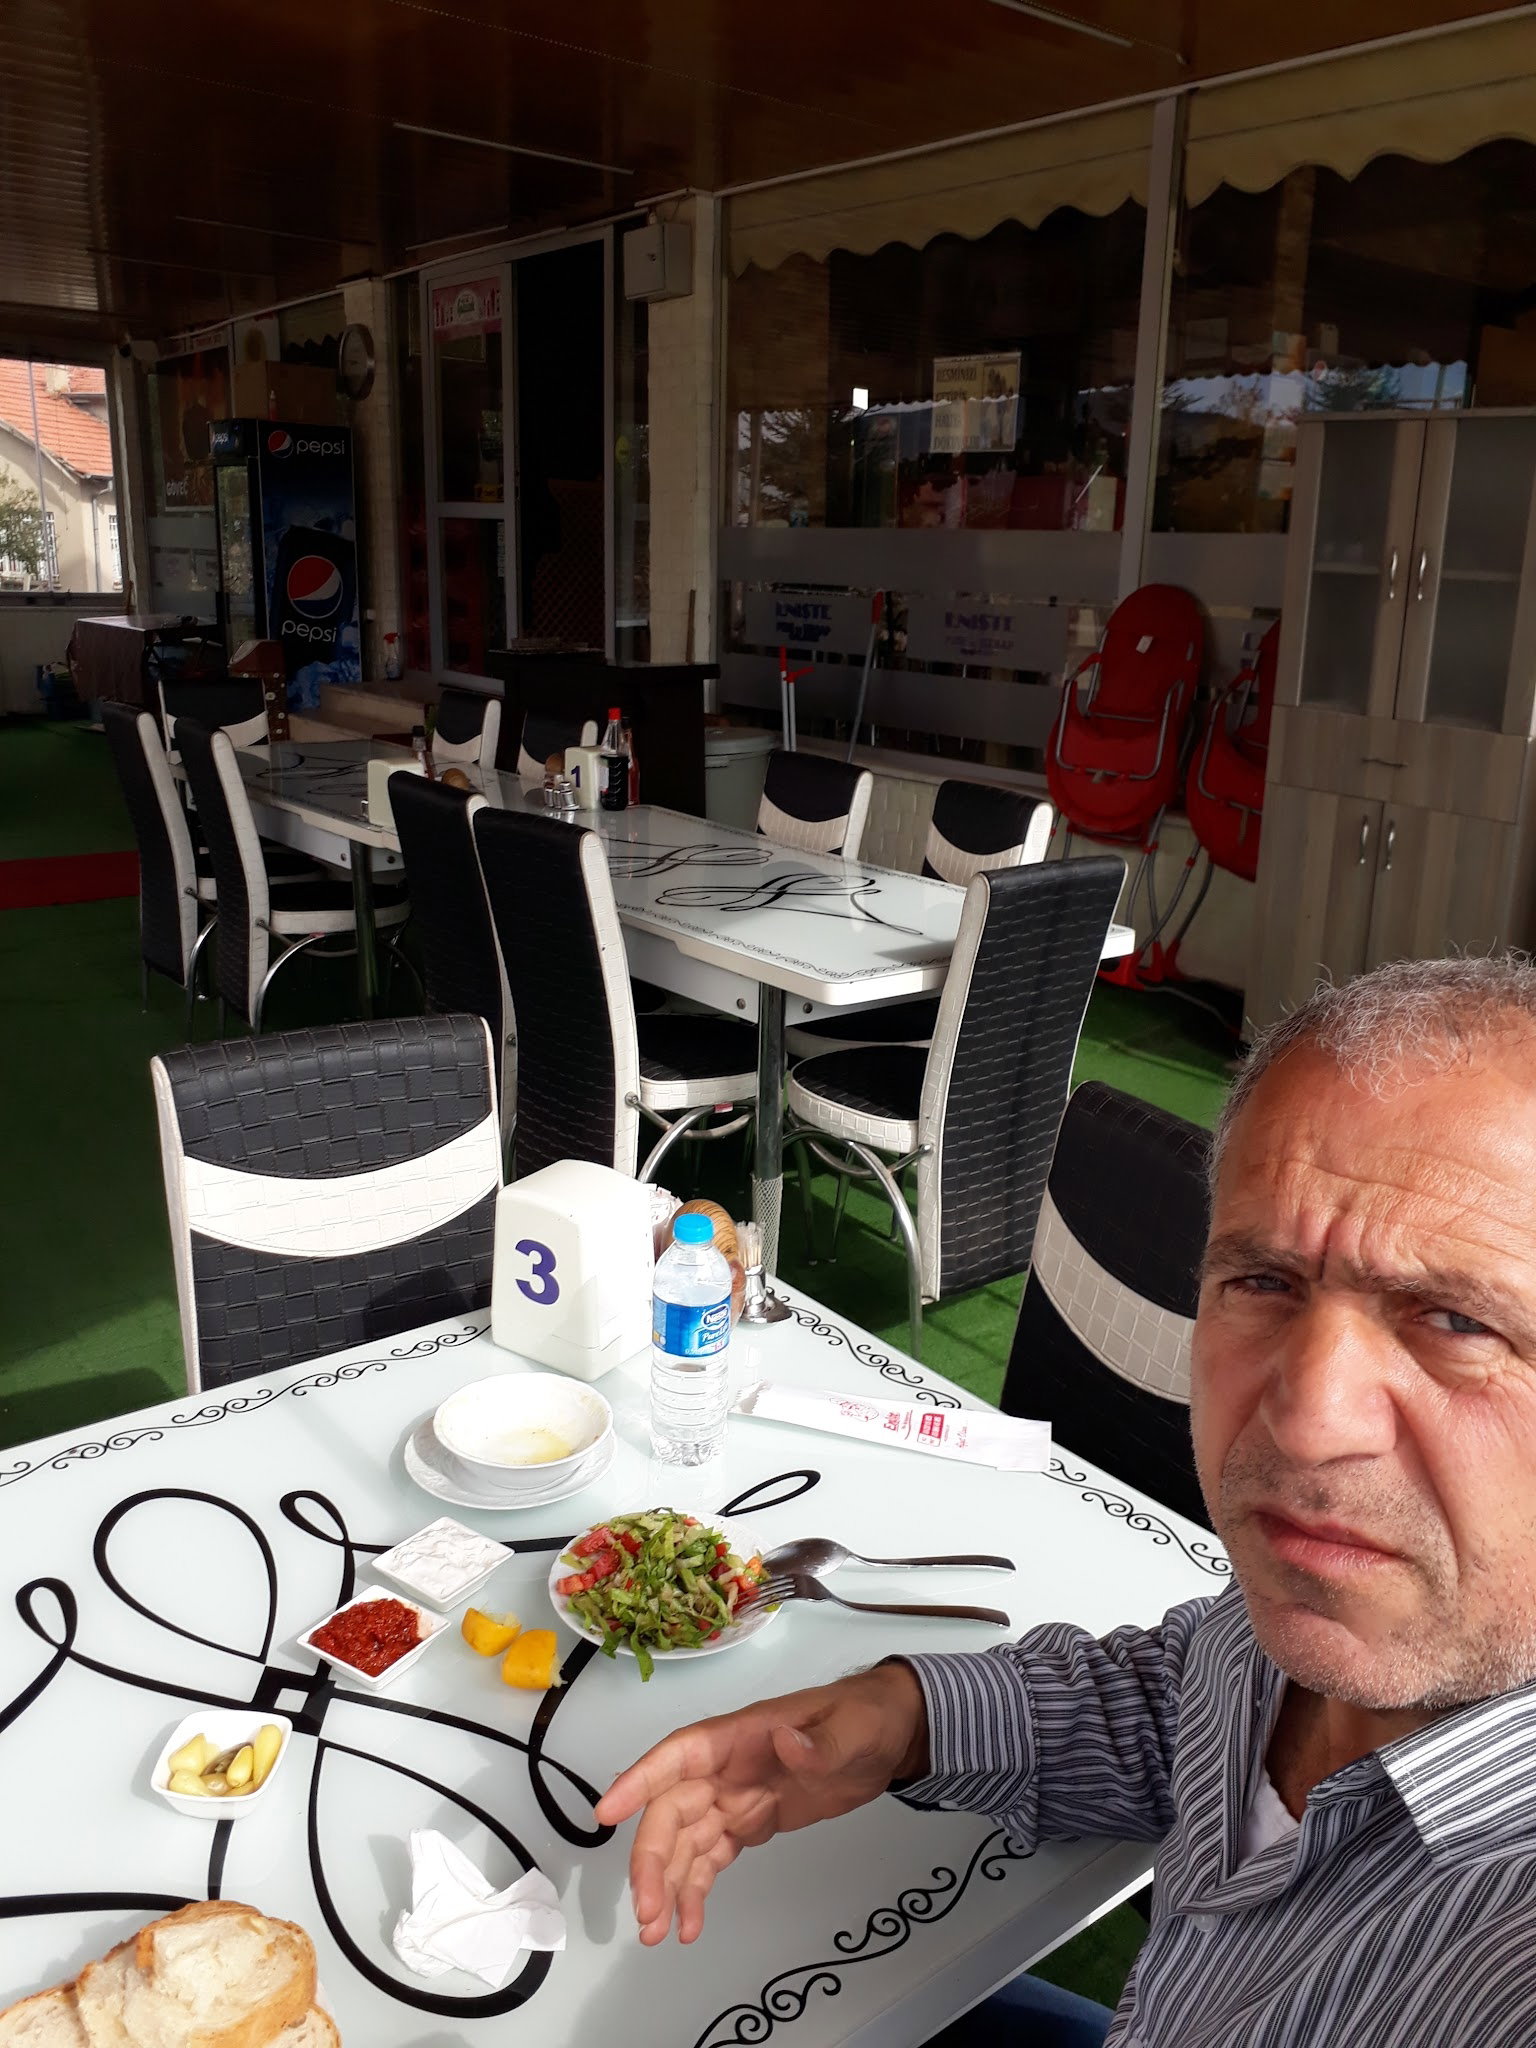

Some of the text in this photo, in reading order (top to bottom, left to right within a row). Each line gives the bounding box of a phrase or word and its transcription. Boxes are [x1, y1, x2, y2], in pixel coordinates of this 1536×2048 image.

[296, 439, 346, 456] pepsi
[281, 620, 338, 644] pepsi
[570, 765, 581, 788] 1
[514, 1239, 560, 1305] 3
